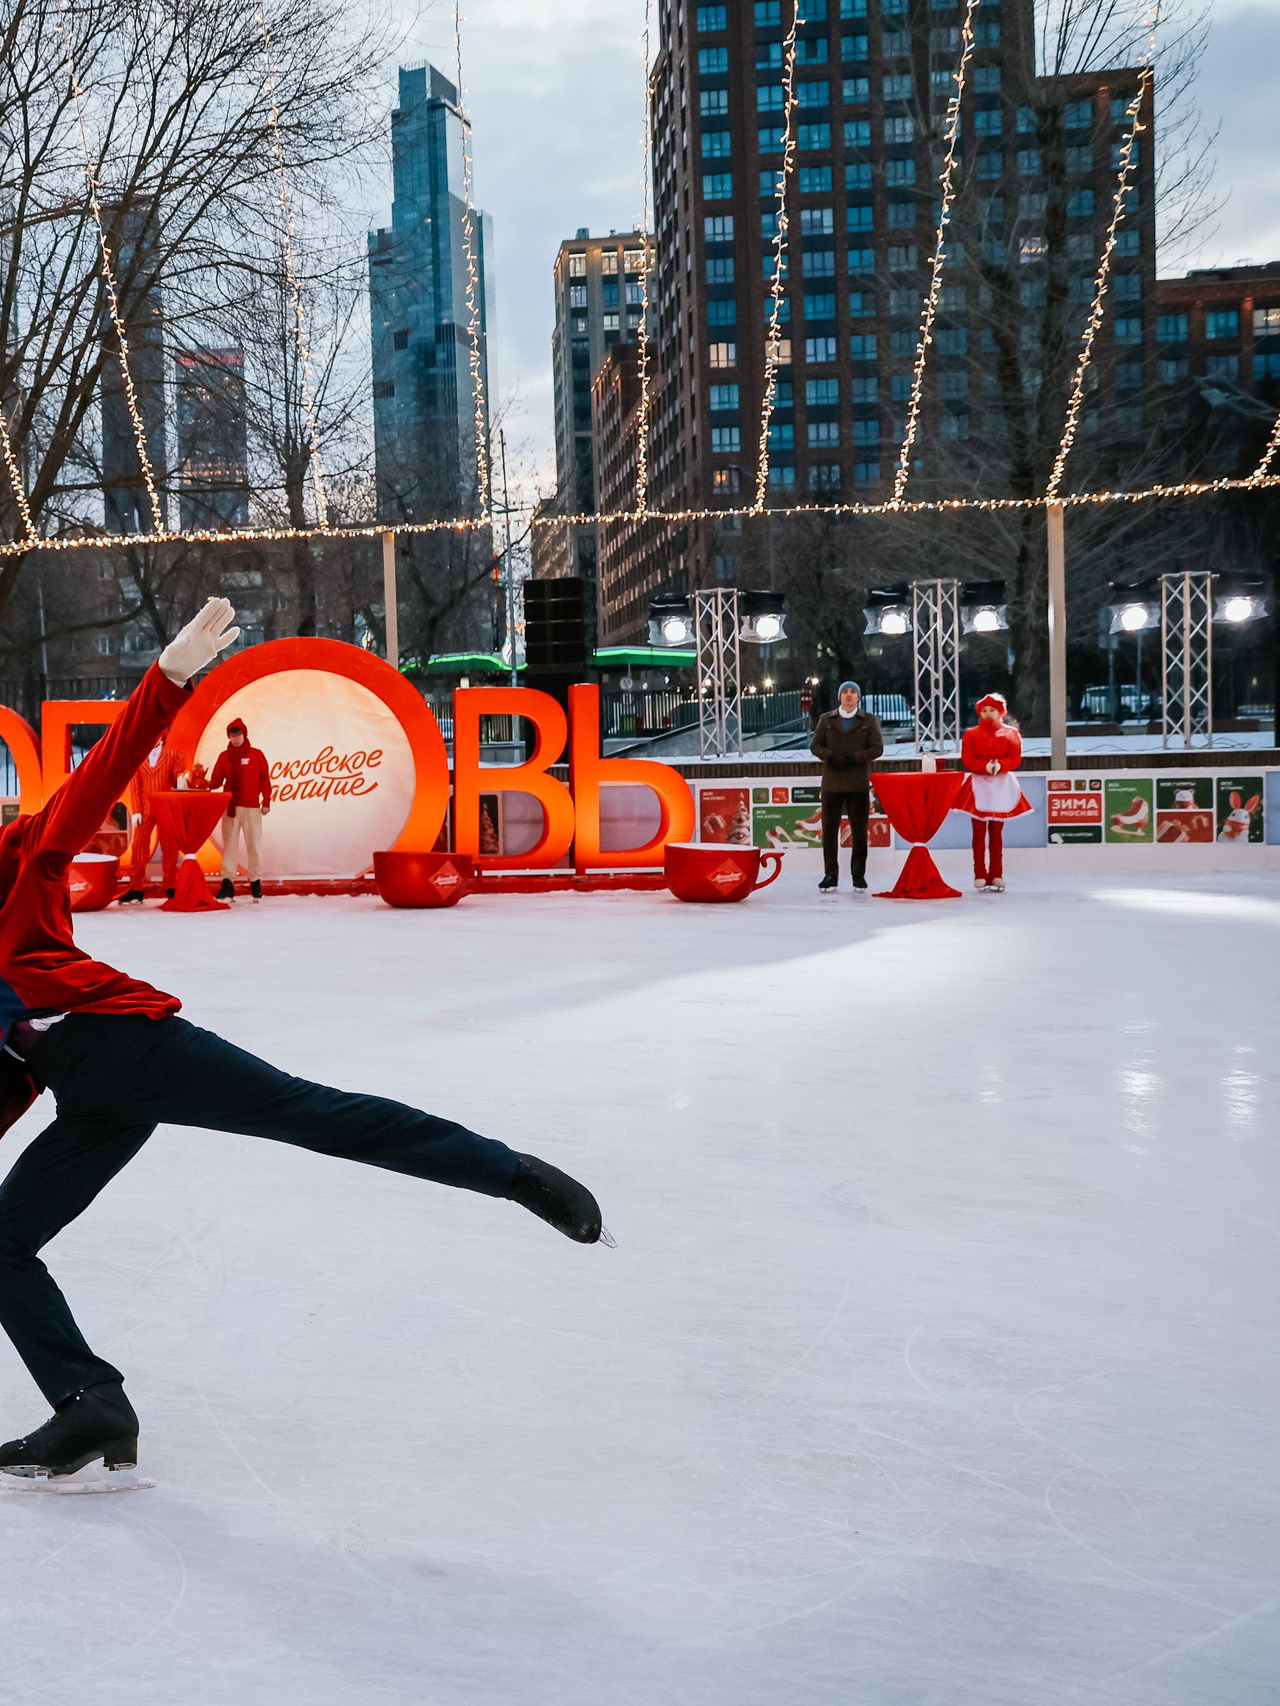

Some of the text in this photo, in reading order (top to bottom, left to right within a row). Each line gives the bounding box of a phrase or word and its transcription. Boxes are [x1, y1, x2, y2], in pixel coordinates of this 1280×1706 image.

[270, 745, 384, 781] сковское
[269, 771, 379, 803] аепитие
[1051, 798, 1099, 810] ЗИМА
